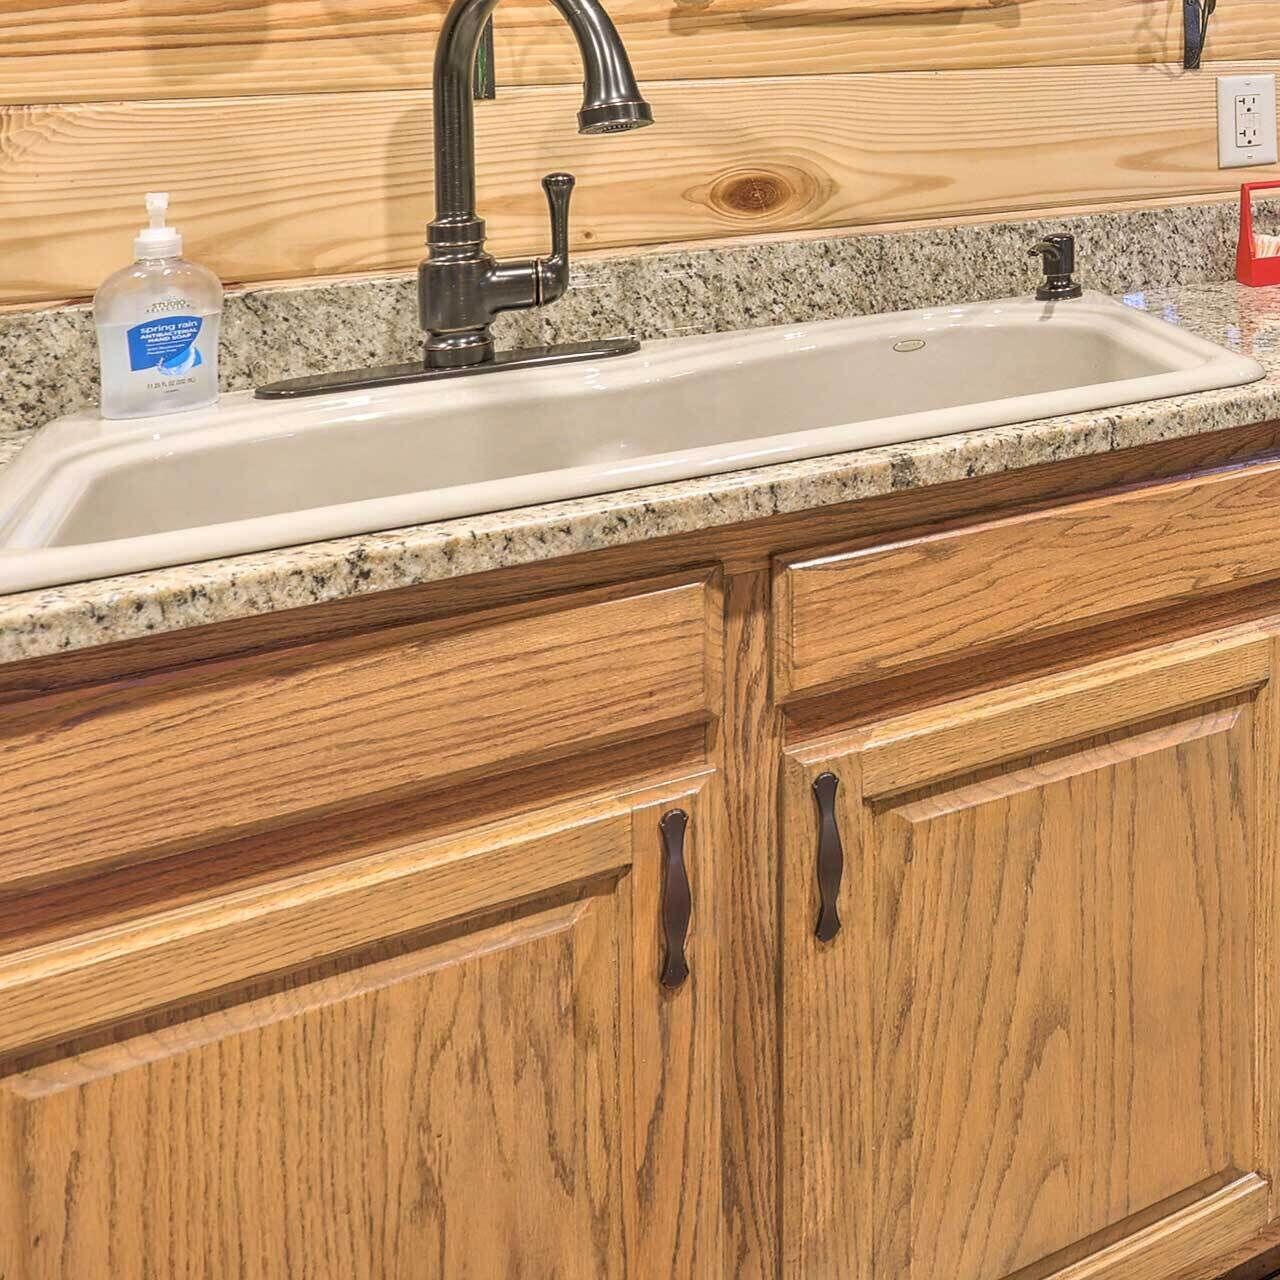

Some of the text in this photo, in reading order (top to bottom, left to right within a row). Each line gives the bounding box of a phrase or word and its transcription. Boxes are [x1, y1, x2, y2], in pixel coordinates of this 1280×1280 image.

[140, 320, 198, 334] spring rain
[140, 328, 198, 340] ANTIBACTERIAL
